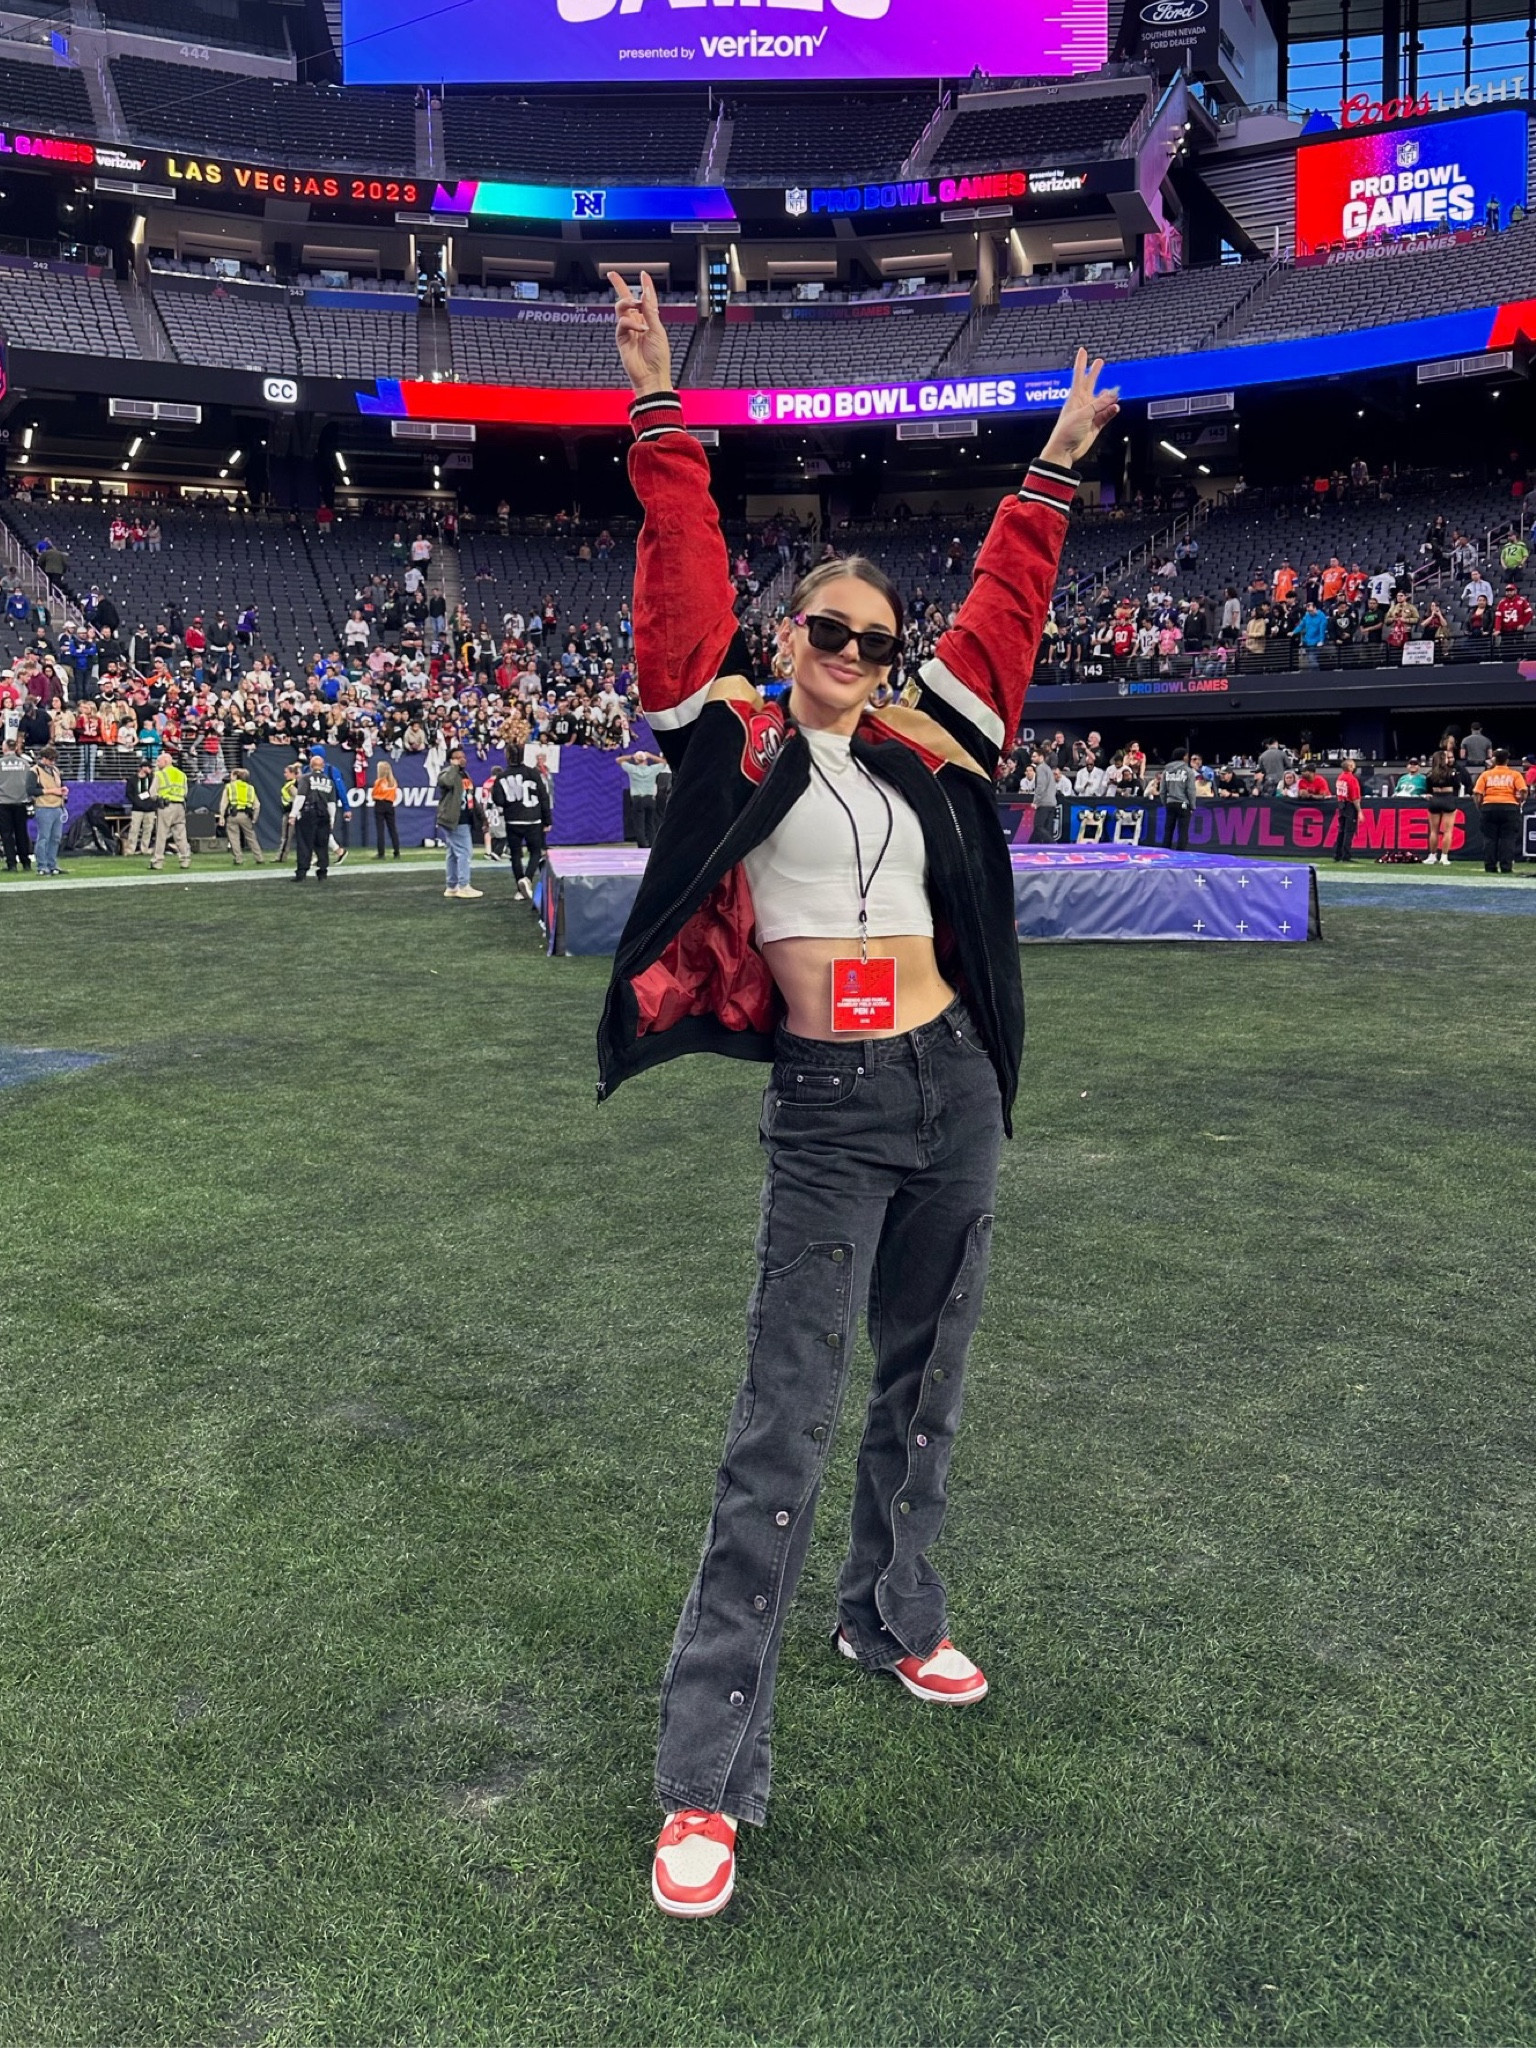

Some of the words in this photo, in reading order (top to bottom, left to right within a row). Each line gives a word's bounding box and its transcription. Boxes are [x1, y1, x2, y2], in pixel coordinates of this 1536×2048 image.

[1152, 1, 1195, 20] Ford
[1141, 28, 1177, 40] SOUTHERN
[1178, 26, 1206, 37] NEVADA
[619, 47, 678, 61] presented
[680, 46, 696, 60] by
[700, 29, 814, 57] verizon
[1150, 40, 1168, 49] FORD
[1169, 37, 1198, 47] DEALERS
[180, 46, 210, 61] 444
[1339, 91, 1433, 129] Coors
[1437, 76, 1526, 112] LIGHT
[15, 136, 95, 164] GAMES
[95, 154, 142, 171] verizon
[167, 158, 222, 184] LAS
[351, 180, 417, 203] 2023
[1029, 176, 1081, 193] verizon
[1350, 174, 1395, 199] PRO
[1399, 164, 1466, 191] BOWL
[811, 188, 861, 213] PRO
[863, 181, 936, 211] BOWL
[939, 172, 1026, 203] GAMES
[1343, 184, 1475, 239] GAMES
[1327, 235, 1457, 265] #PROBOWLGAMES
[517, 310, 619, 323] #PROBOWLGAM
[851, 305, 891, 317] GAMES
[268, 382, 293, 398] CC
[776, 393, 829, 419] PRO
[835, 387, 916, 417] BOWL
[919, 380, 1016, 411] GAMES
[1374, 581, 1383, 595] 4
[1503, 610, 1518, 622] 54
[1083, 664, 1103, 676] 143
[1129, 682, 1150, 694] PRO
[1153, 681, 1187, 693] BOWL
[1188, 678, 1229, 691] GAMES
[84, 720, 98, 736] 12
[499, 774, 540, 808] WC
[869, 1007, 876, 1016] A
